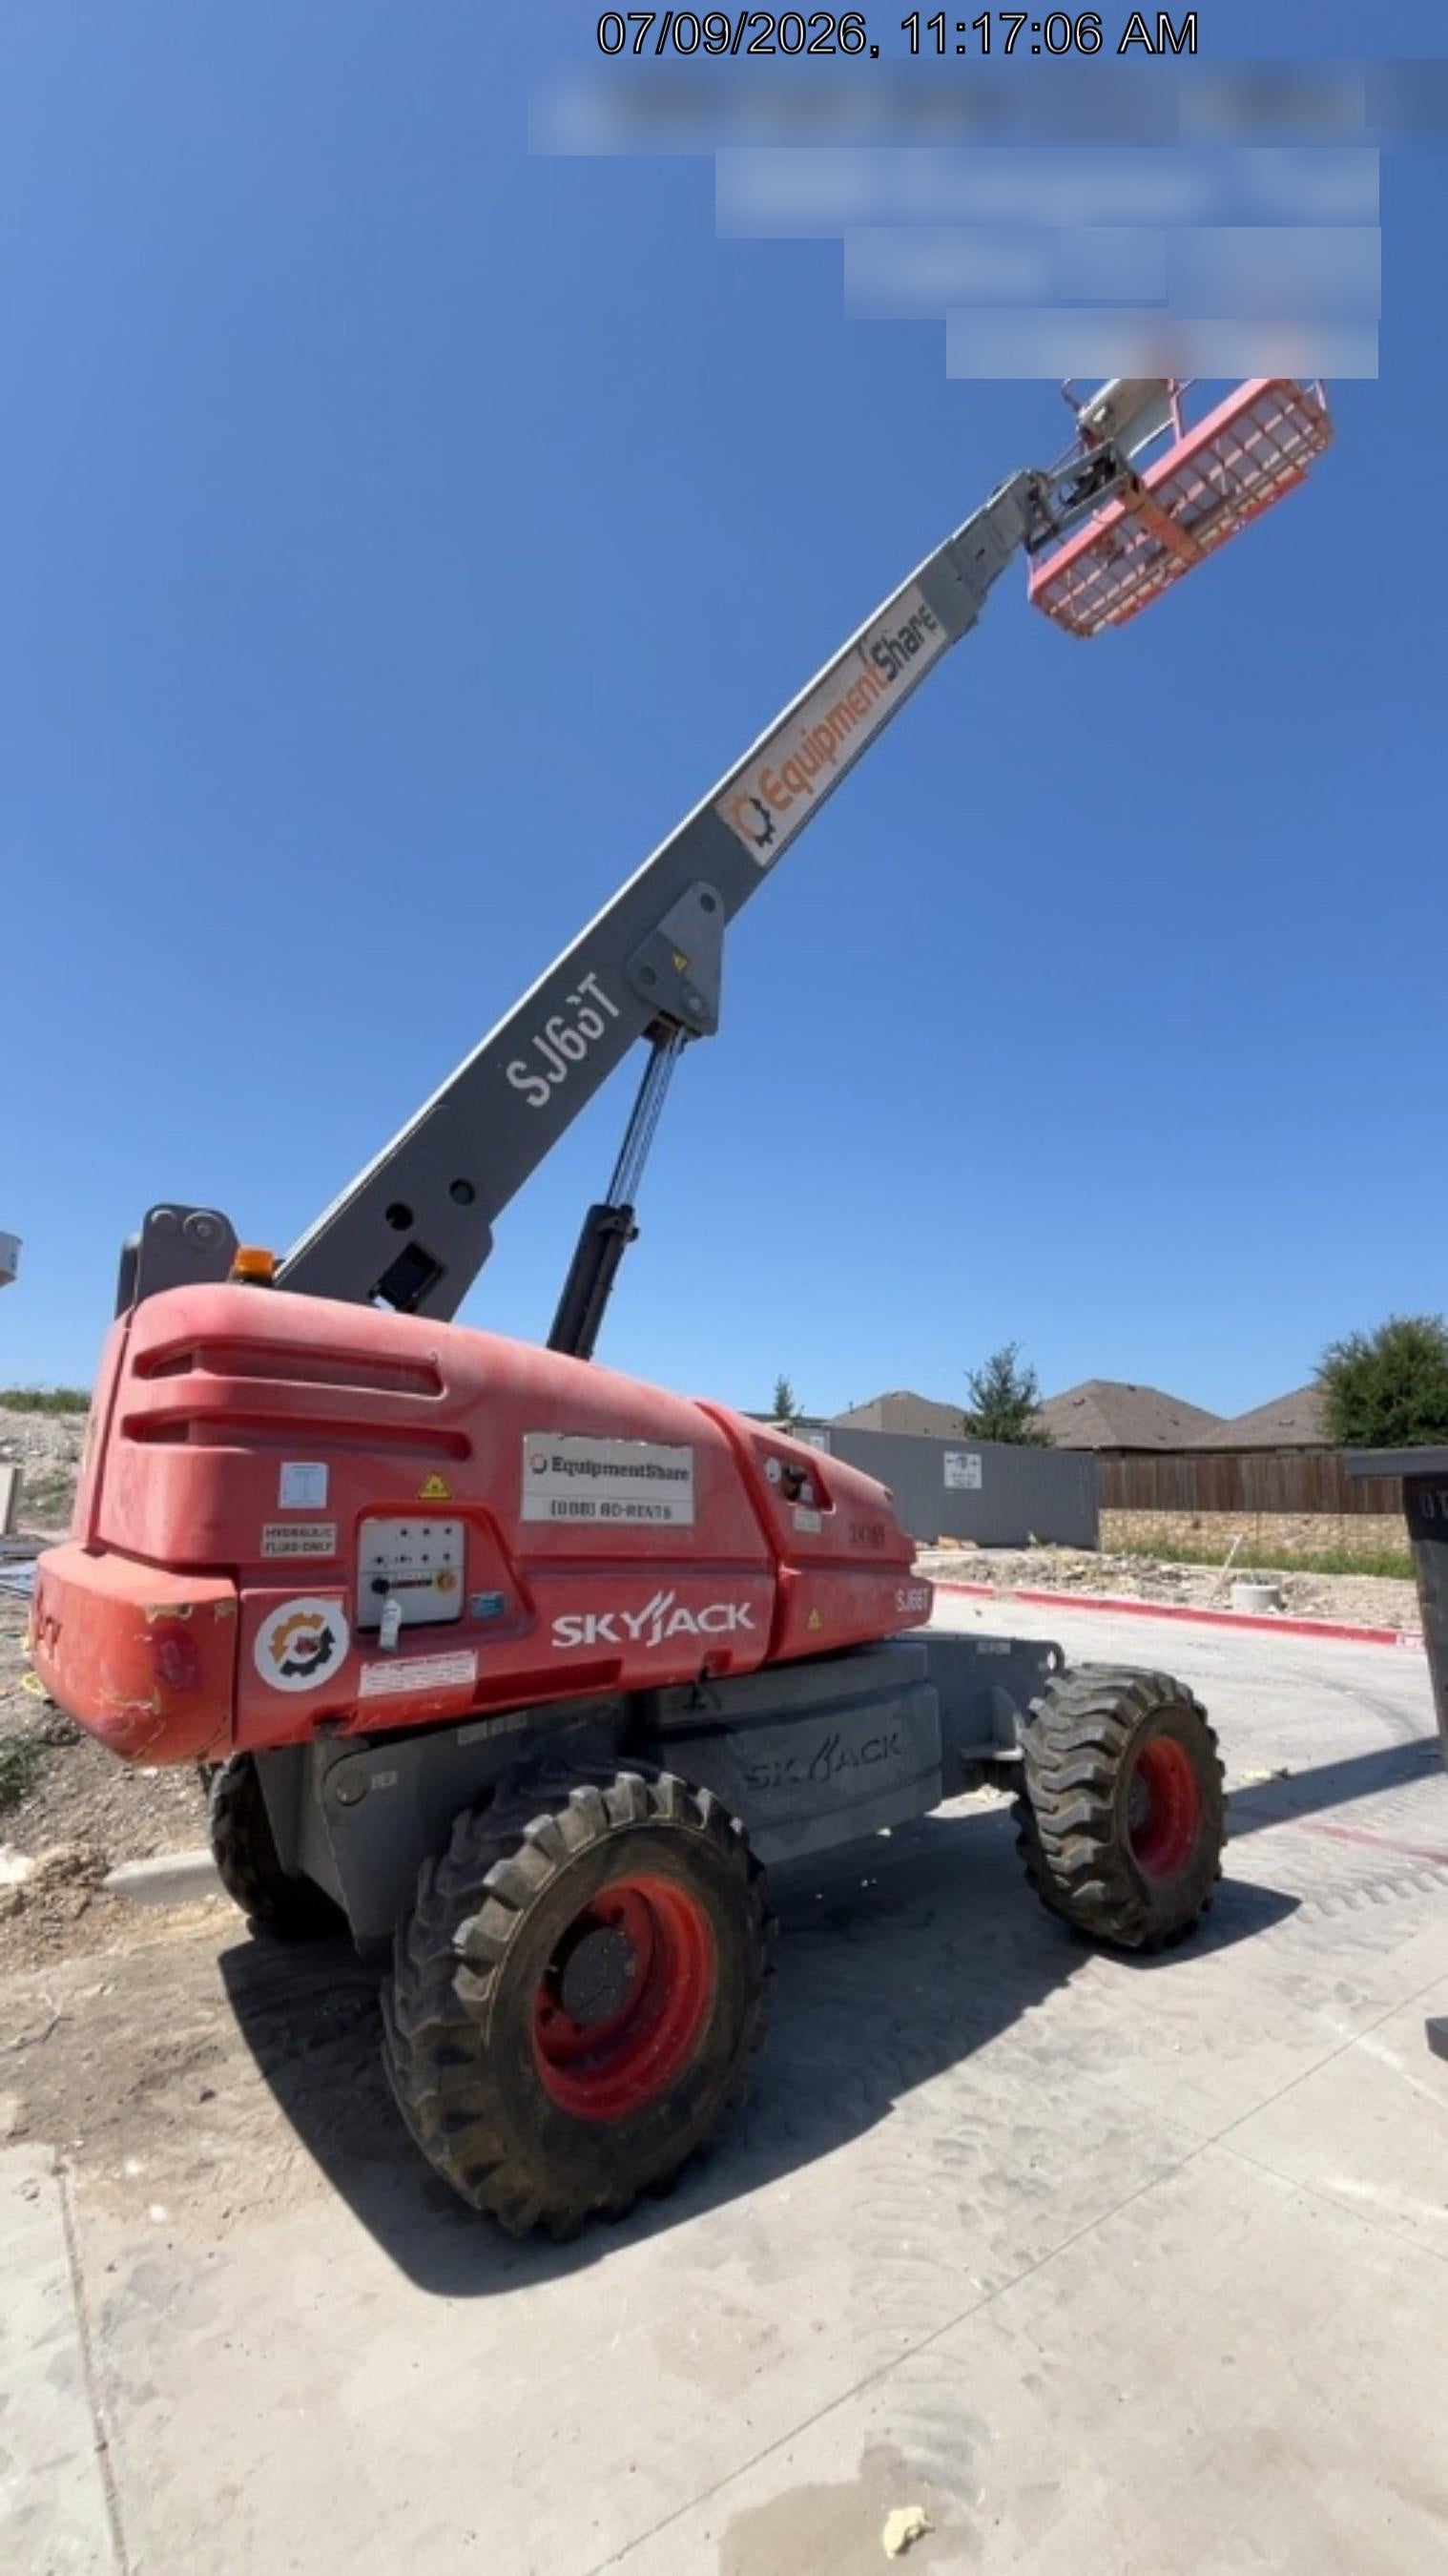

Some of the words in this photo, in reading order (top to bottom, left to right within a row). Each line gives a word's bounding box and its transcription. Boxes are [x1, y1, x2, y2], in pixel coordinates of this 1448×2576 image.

[756, 602, 938, 811] EquipmentShare
[550, 1455, 690, 1482] EquipmentShare
[550, 1589, 756, 1648] SKYJACK
